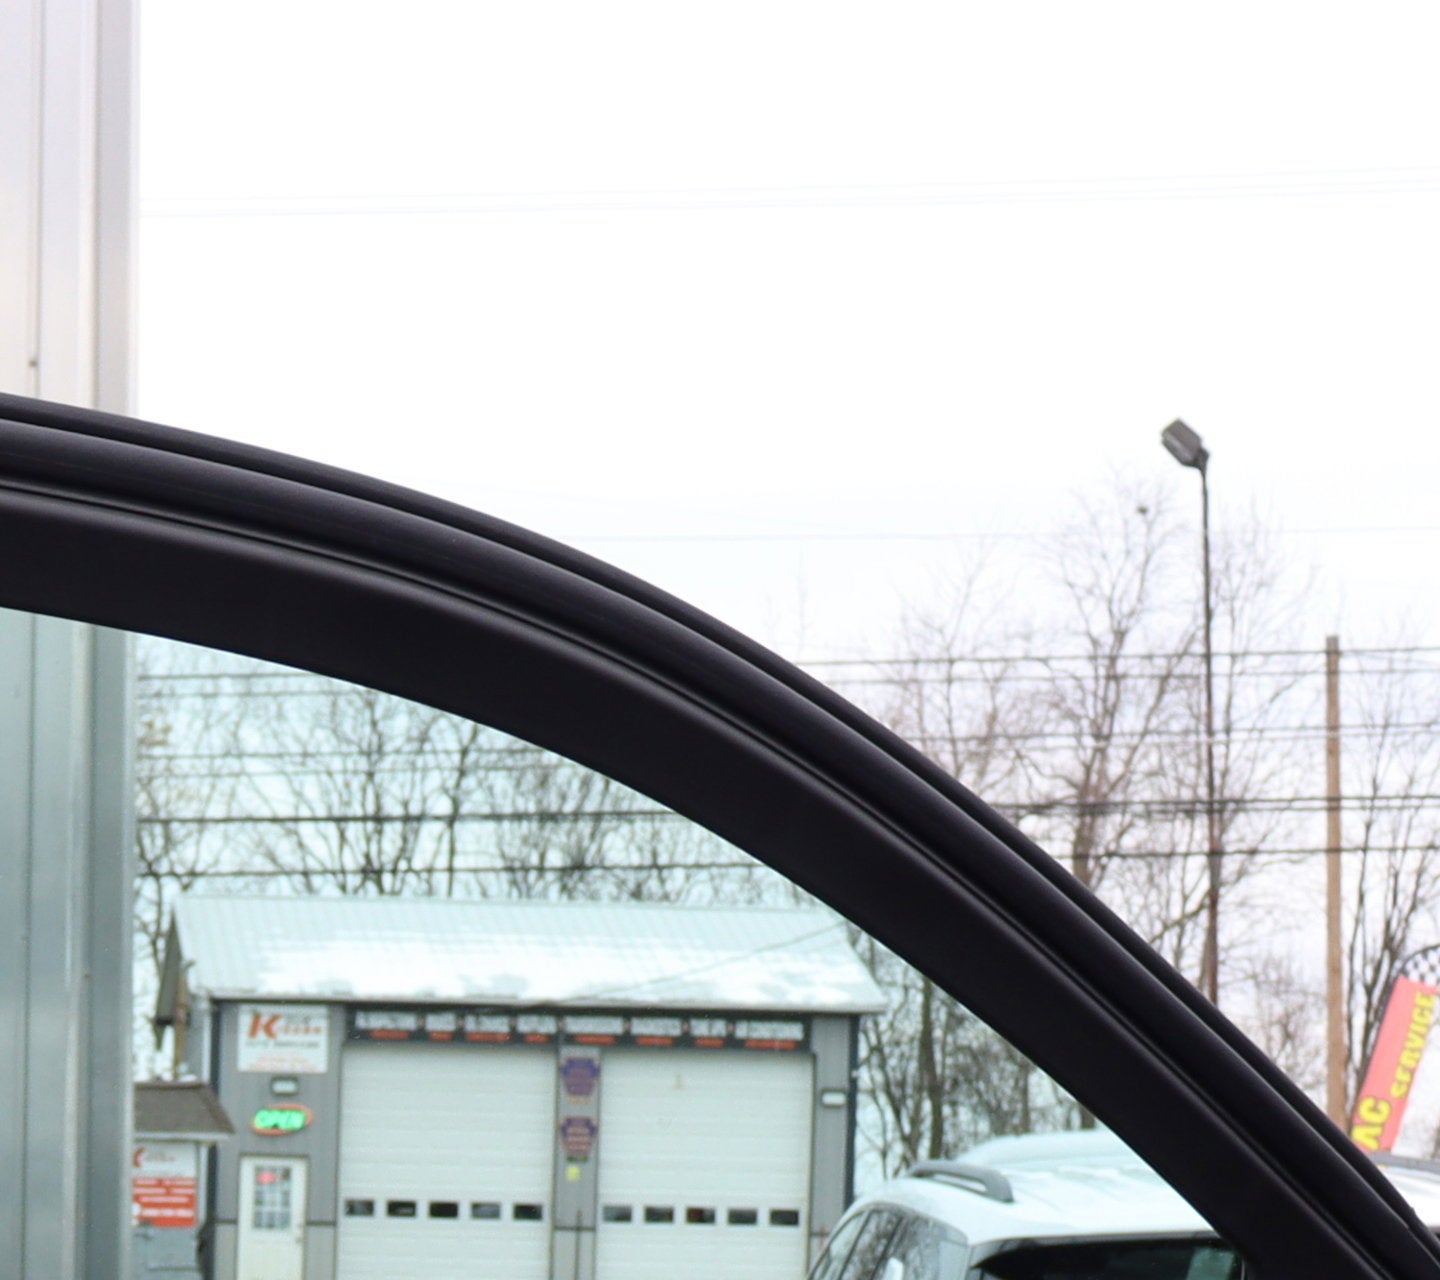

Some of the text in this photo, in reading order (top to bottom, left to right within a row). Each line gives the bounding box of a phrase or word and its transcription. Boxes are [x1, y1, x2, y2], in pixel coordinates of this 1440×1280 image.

[1350, 992, 1436, 1151] AC SERVICE
[254, 1107, 307, 1131] OPEN
